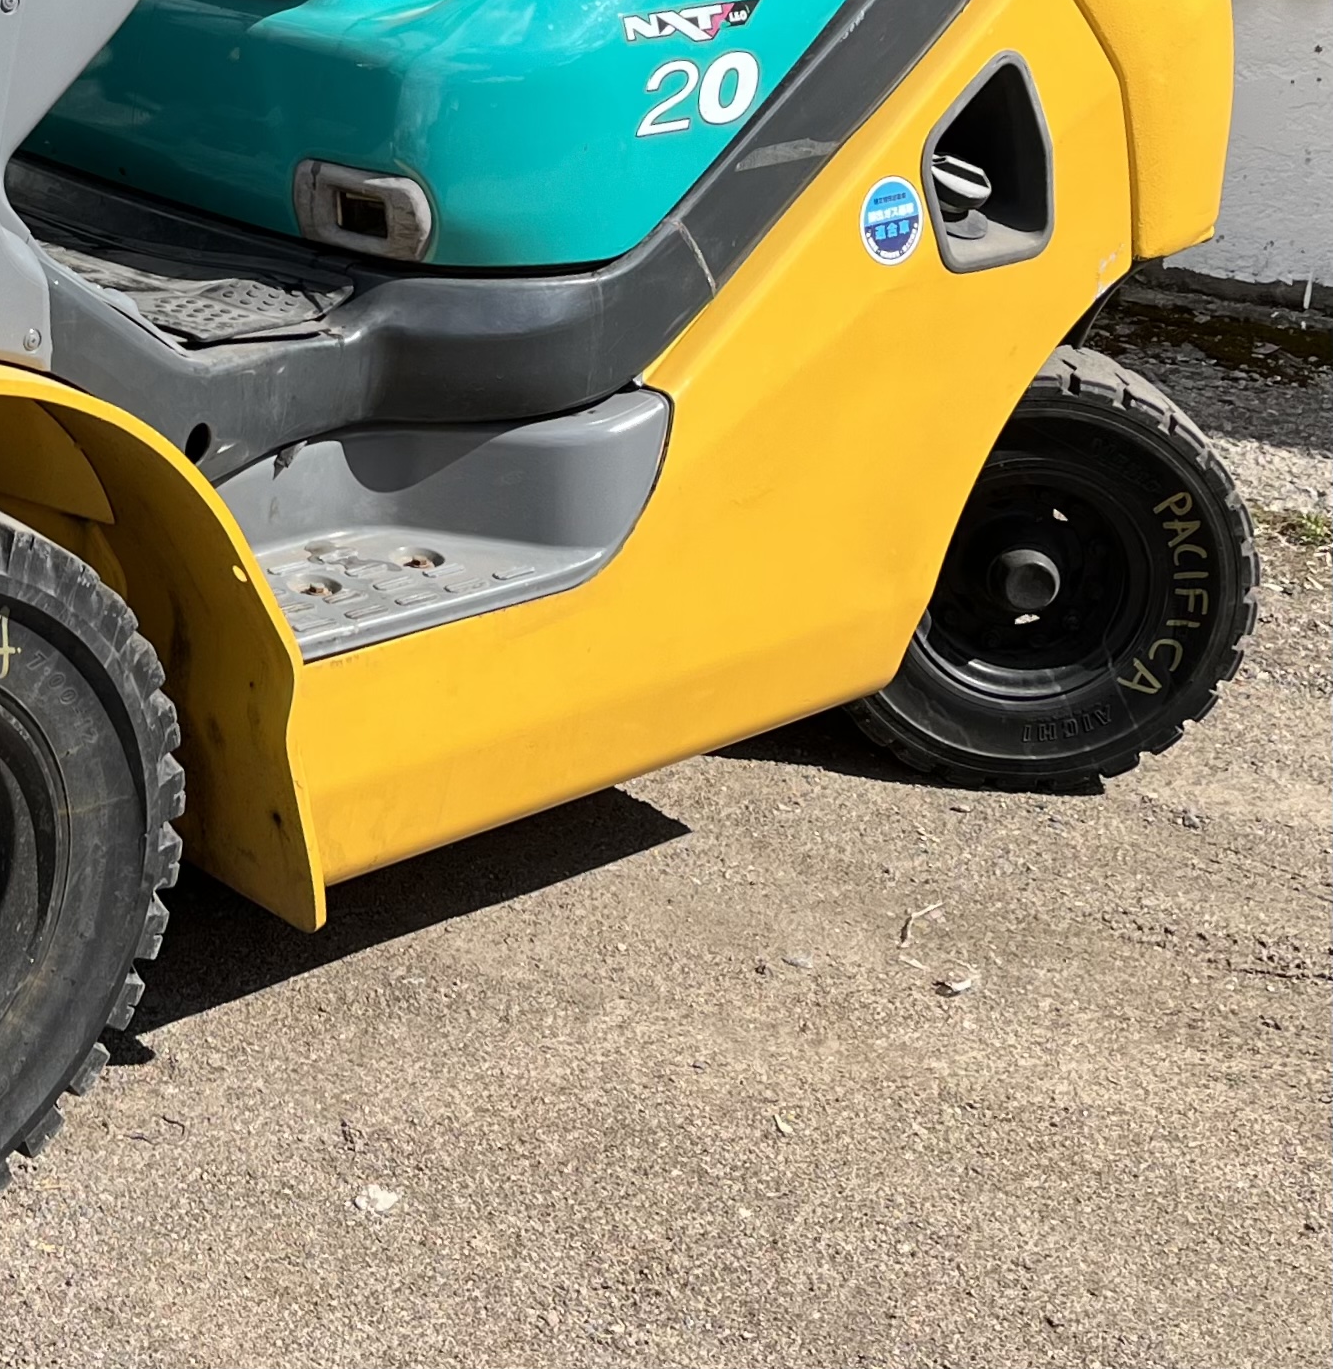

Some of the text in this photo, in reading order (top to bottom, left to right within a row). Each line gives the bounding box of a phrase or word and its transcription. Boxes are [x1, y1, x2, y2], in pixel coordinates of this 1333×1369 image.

[622, 4, 723, 42] NXT
[635, 50, 760, 138] 20
[1116, 491, 1211, 695] PACIFICA
